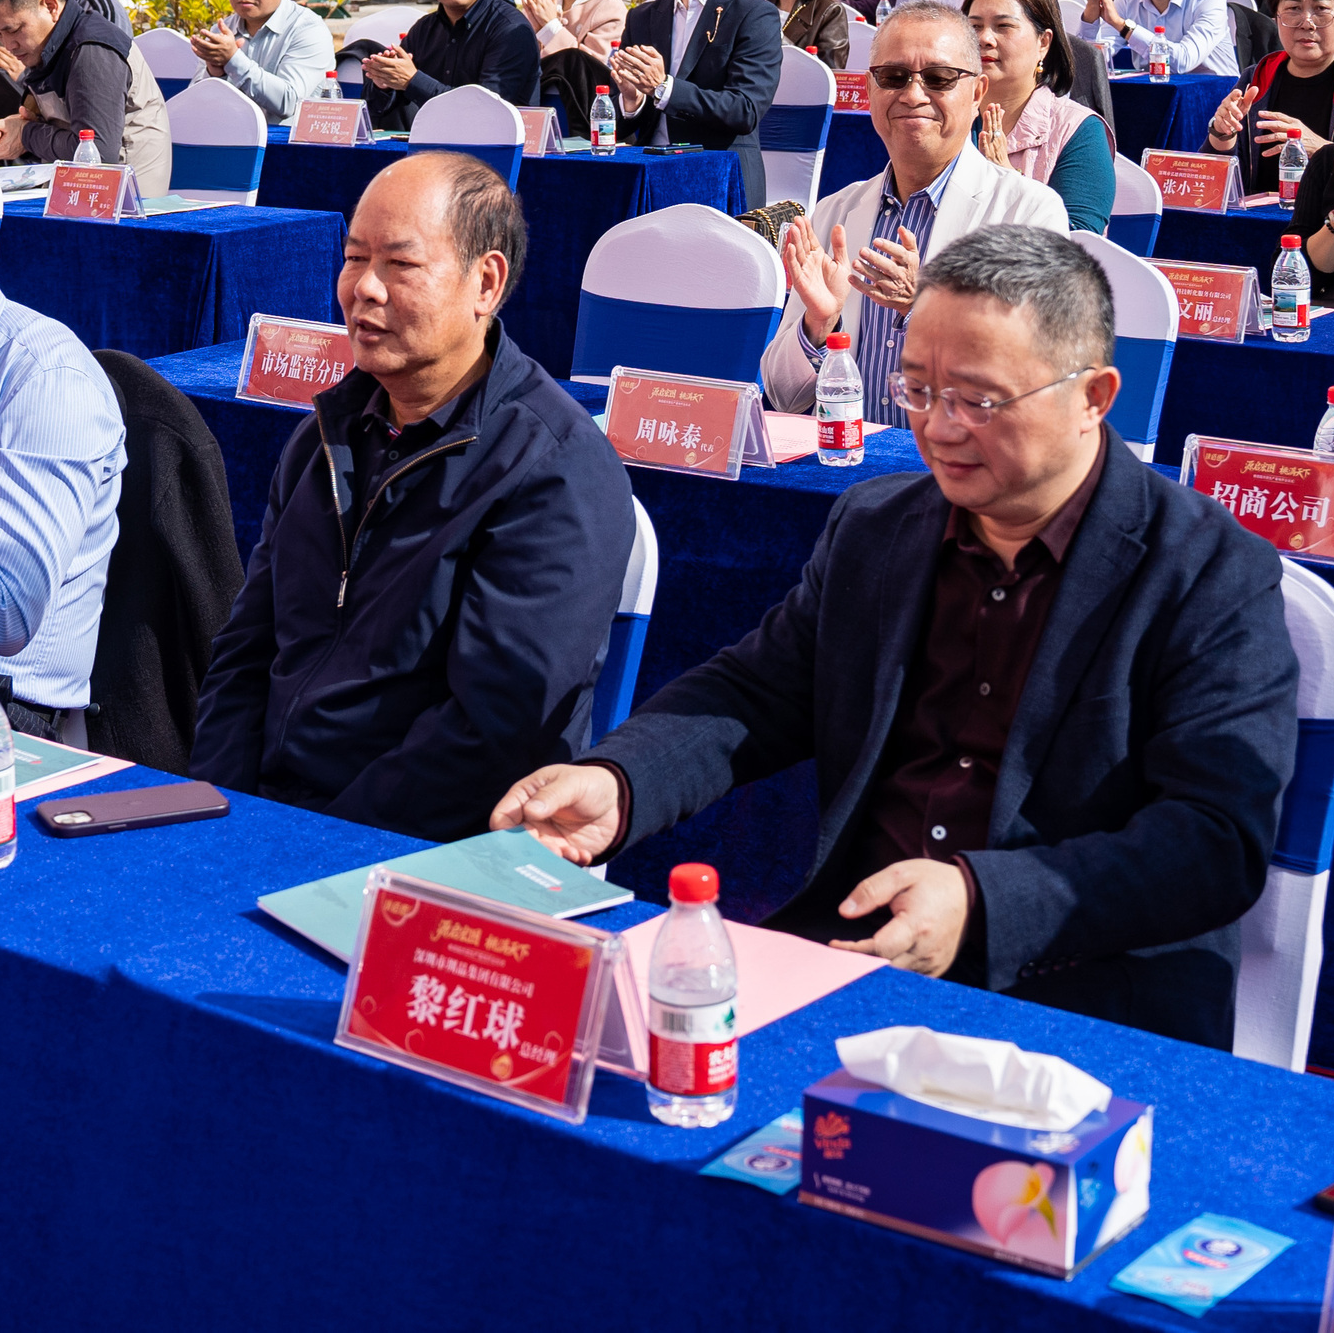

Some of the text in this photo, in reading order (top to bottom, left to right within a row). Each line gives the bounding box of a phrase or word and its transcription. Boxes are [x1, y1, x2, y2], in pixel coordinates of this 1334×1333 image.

[1163, 178, 1206, 198] 张小兰
[1179, 298, 1214, 321] 文丽
[261, 349, 345, 385] 市场监管分局
[634, 417, 715, 453] 周咏泰 代表
[1209, 480, 1331, 528] 招商公司
[405, 974, 559, 1068] 黎红球 总经理
